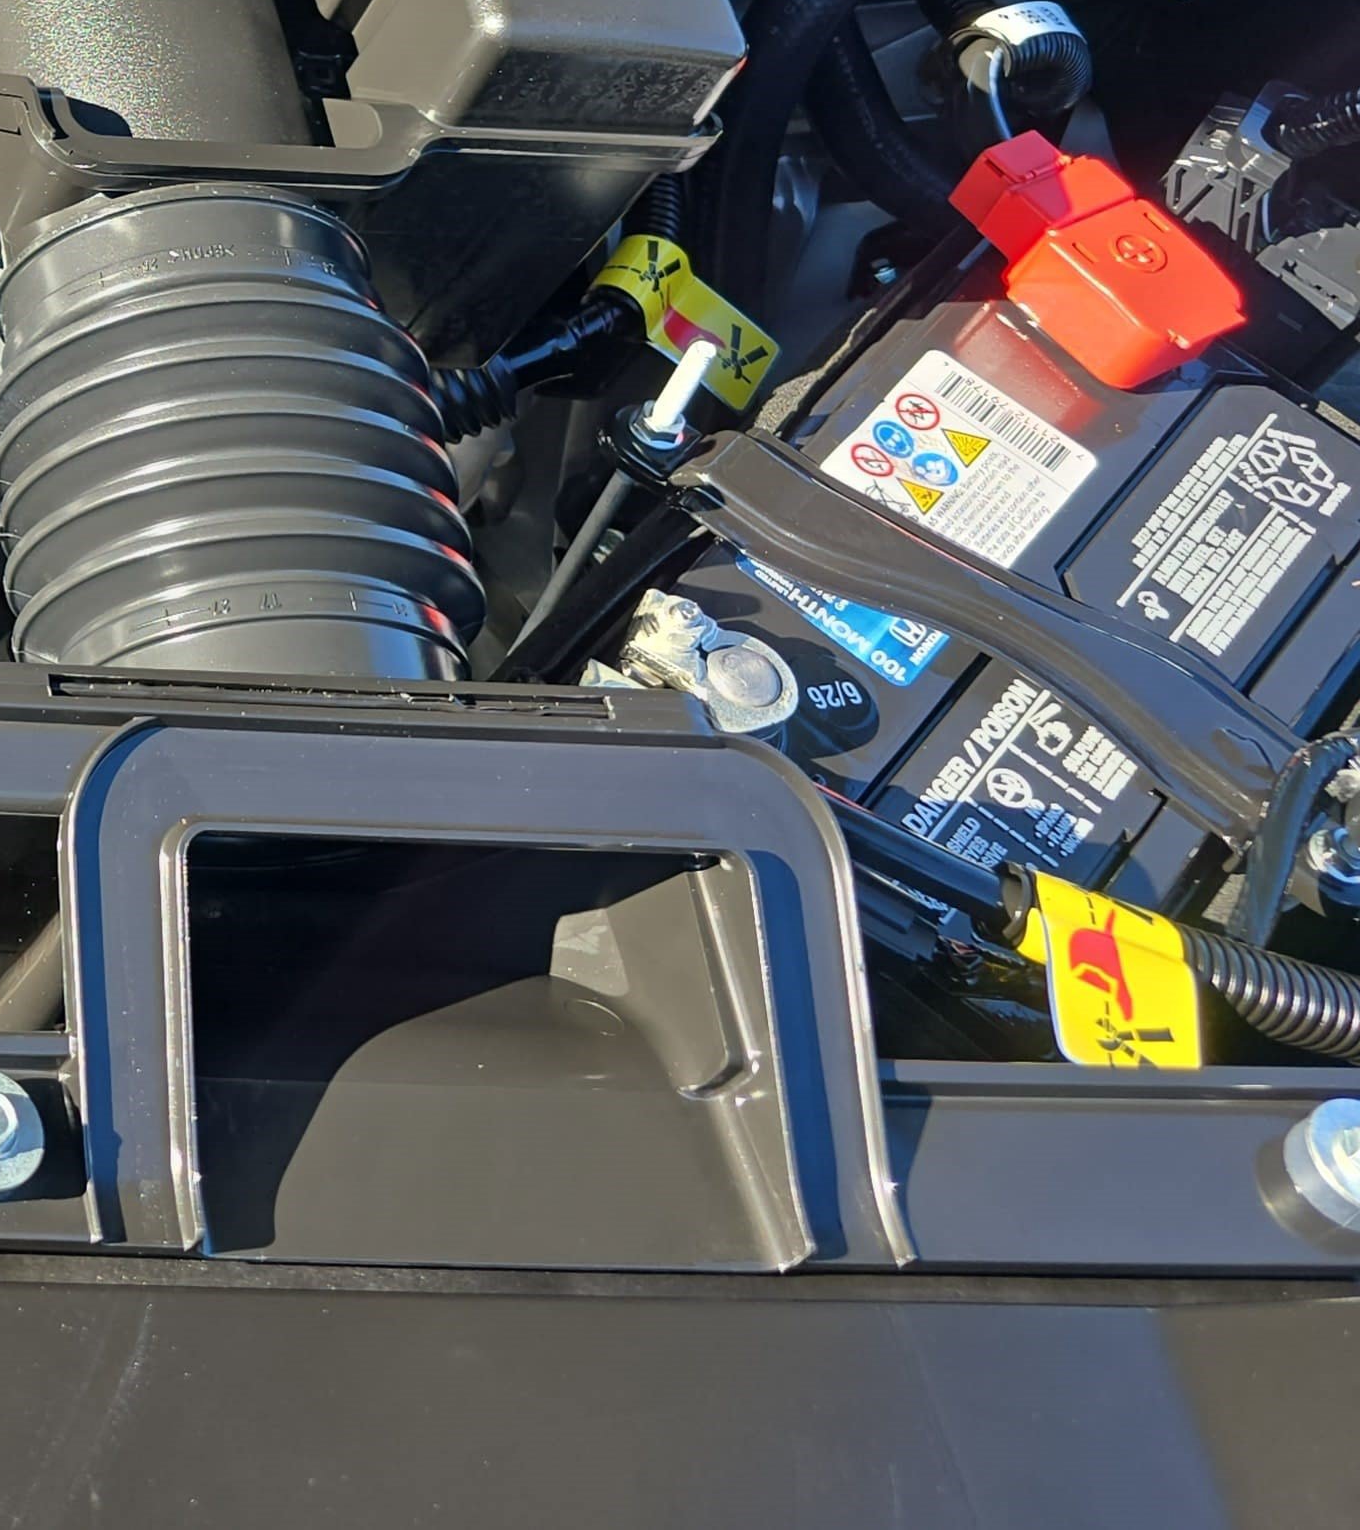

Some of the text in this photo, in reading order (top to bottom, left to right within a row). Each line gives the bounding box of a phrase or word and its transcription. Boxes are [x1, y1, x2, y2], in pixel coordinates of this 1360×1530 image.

[787, 585, 874, 656] MONTH
[868, 645, 910, 683] 100
[807, 681, 863, 704] 6/26
[944, 814, 982, 855] SHIELD
